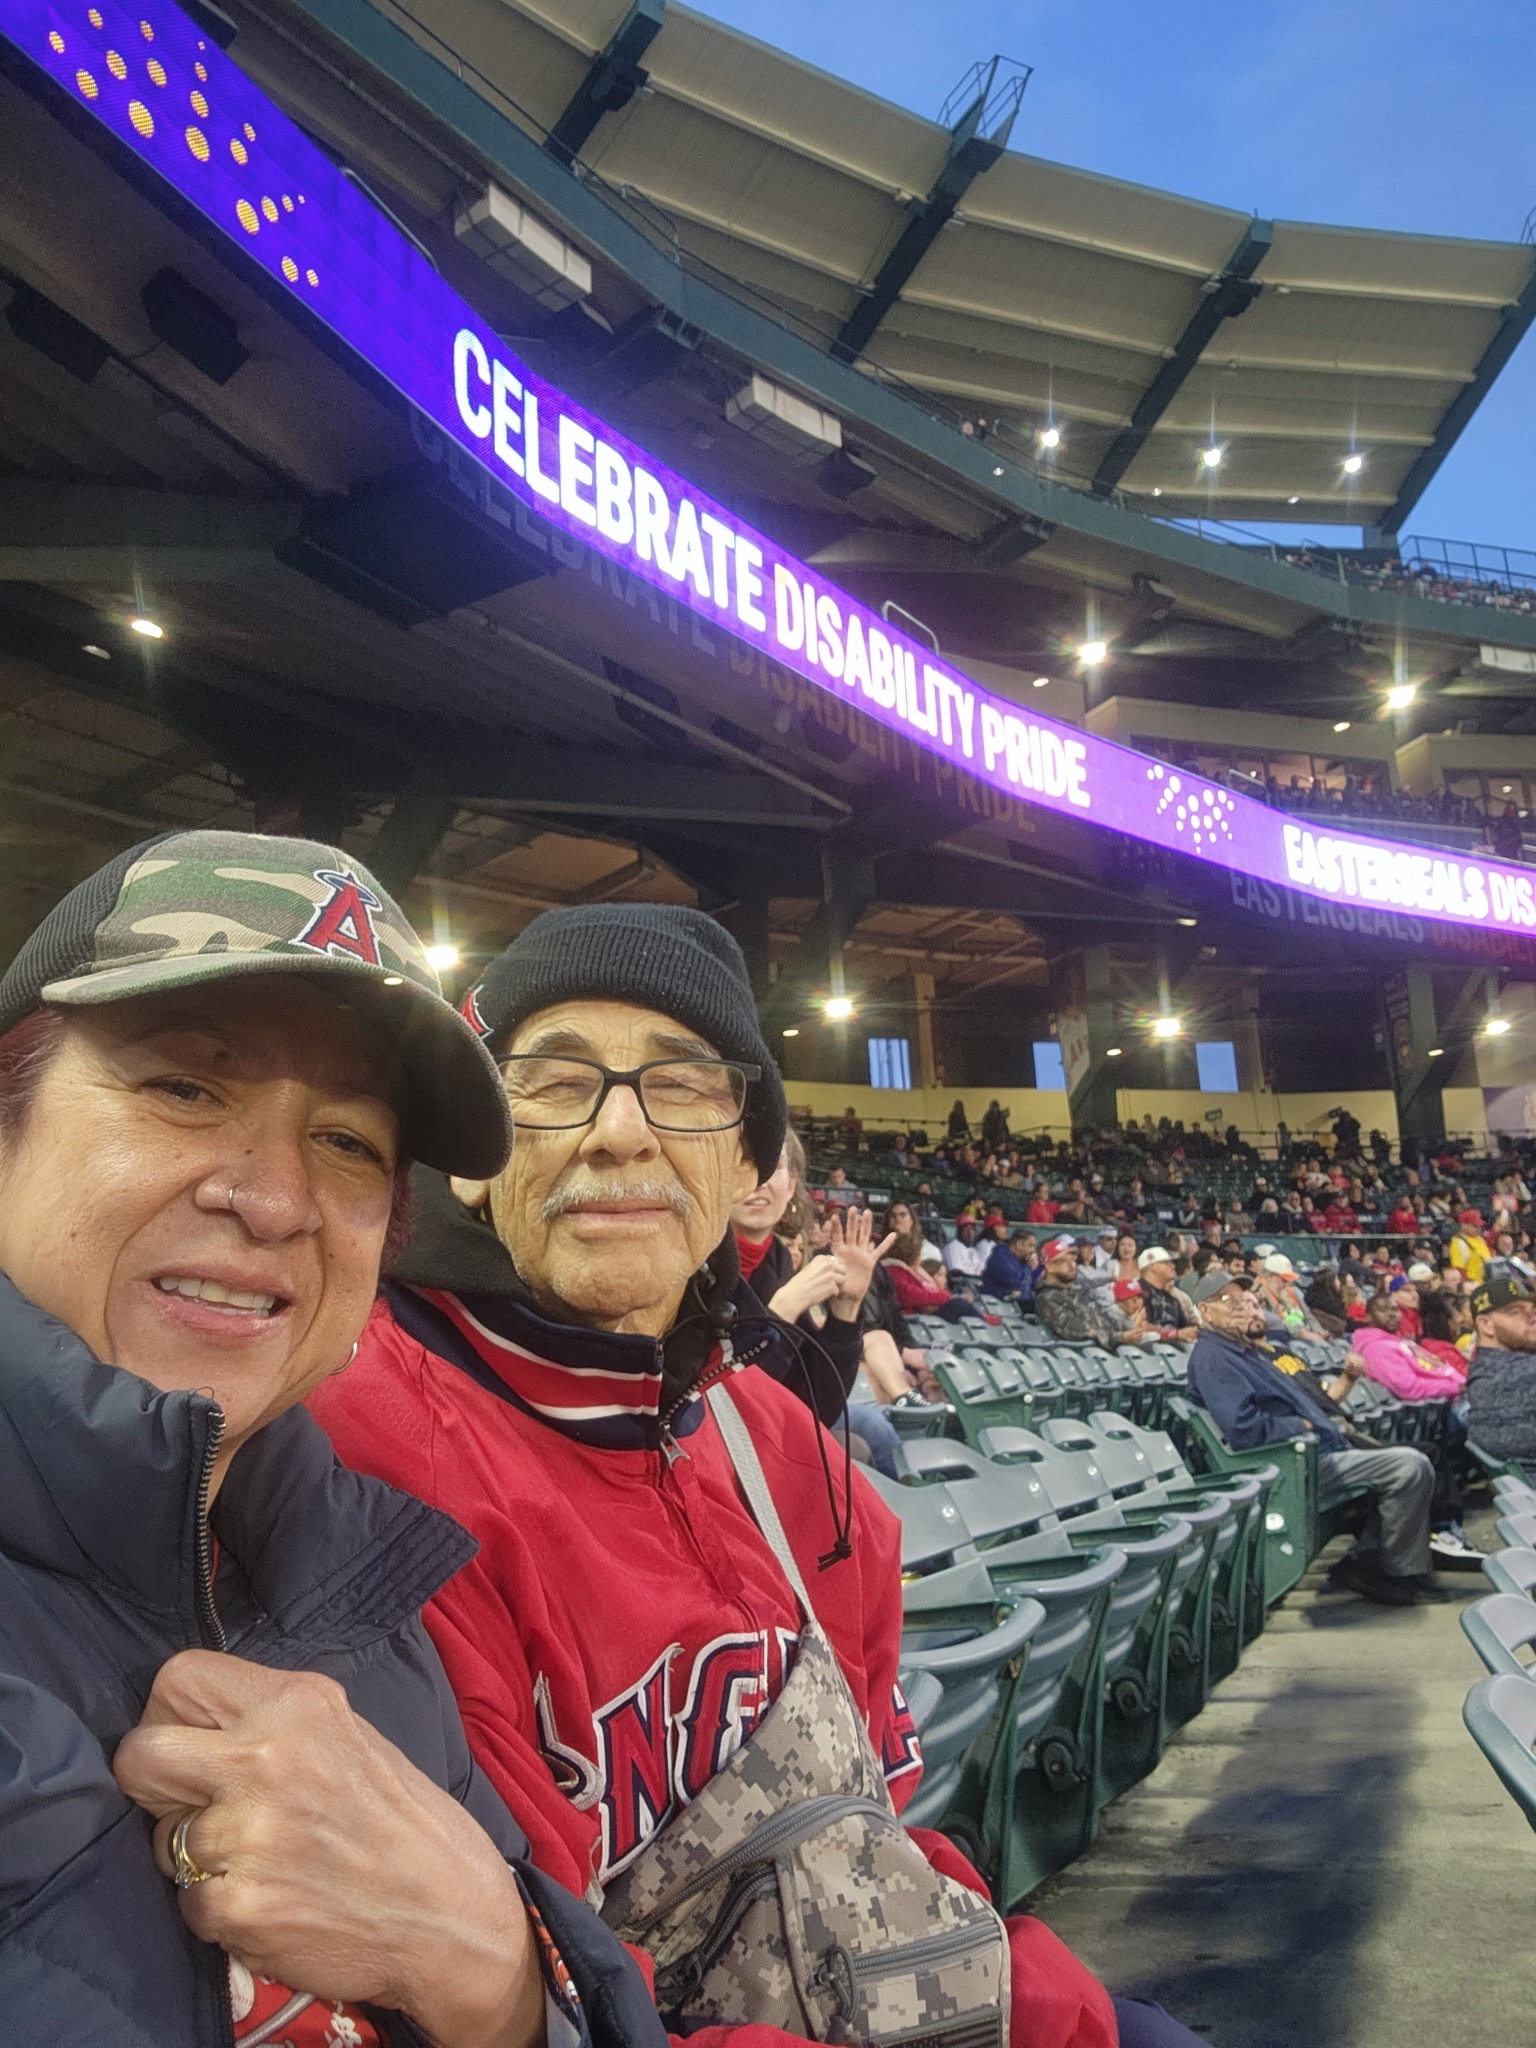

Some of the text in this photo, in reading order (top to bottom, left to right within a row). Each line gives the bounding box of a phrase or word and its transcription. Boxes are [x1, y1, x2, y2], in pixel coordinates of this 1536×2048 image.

[454, 328, 767, 633] CELEBRATE
[773, 562, 976, 759] DISABILITY
[980, 703, 1091, 808] PRIDE
[287, 868, 384, 968] A
[1282, 824, 1536, 927] EASTERSEALS DIS
